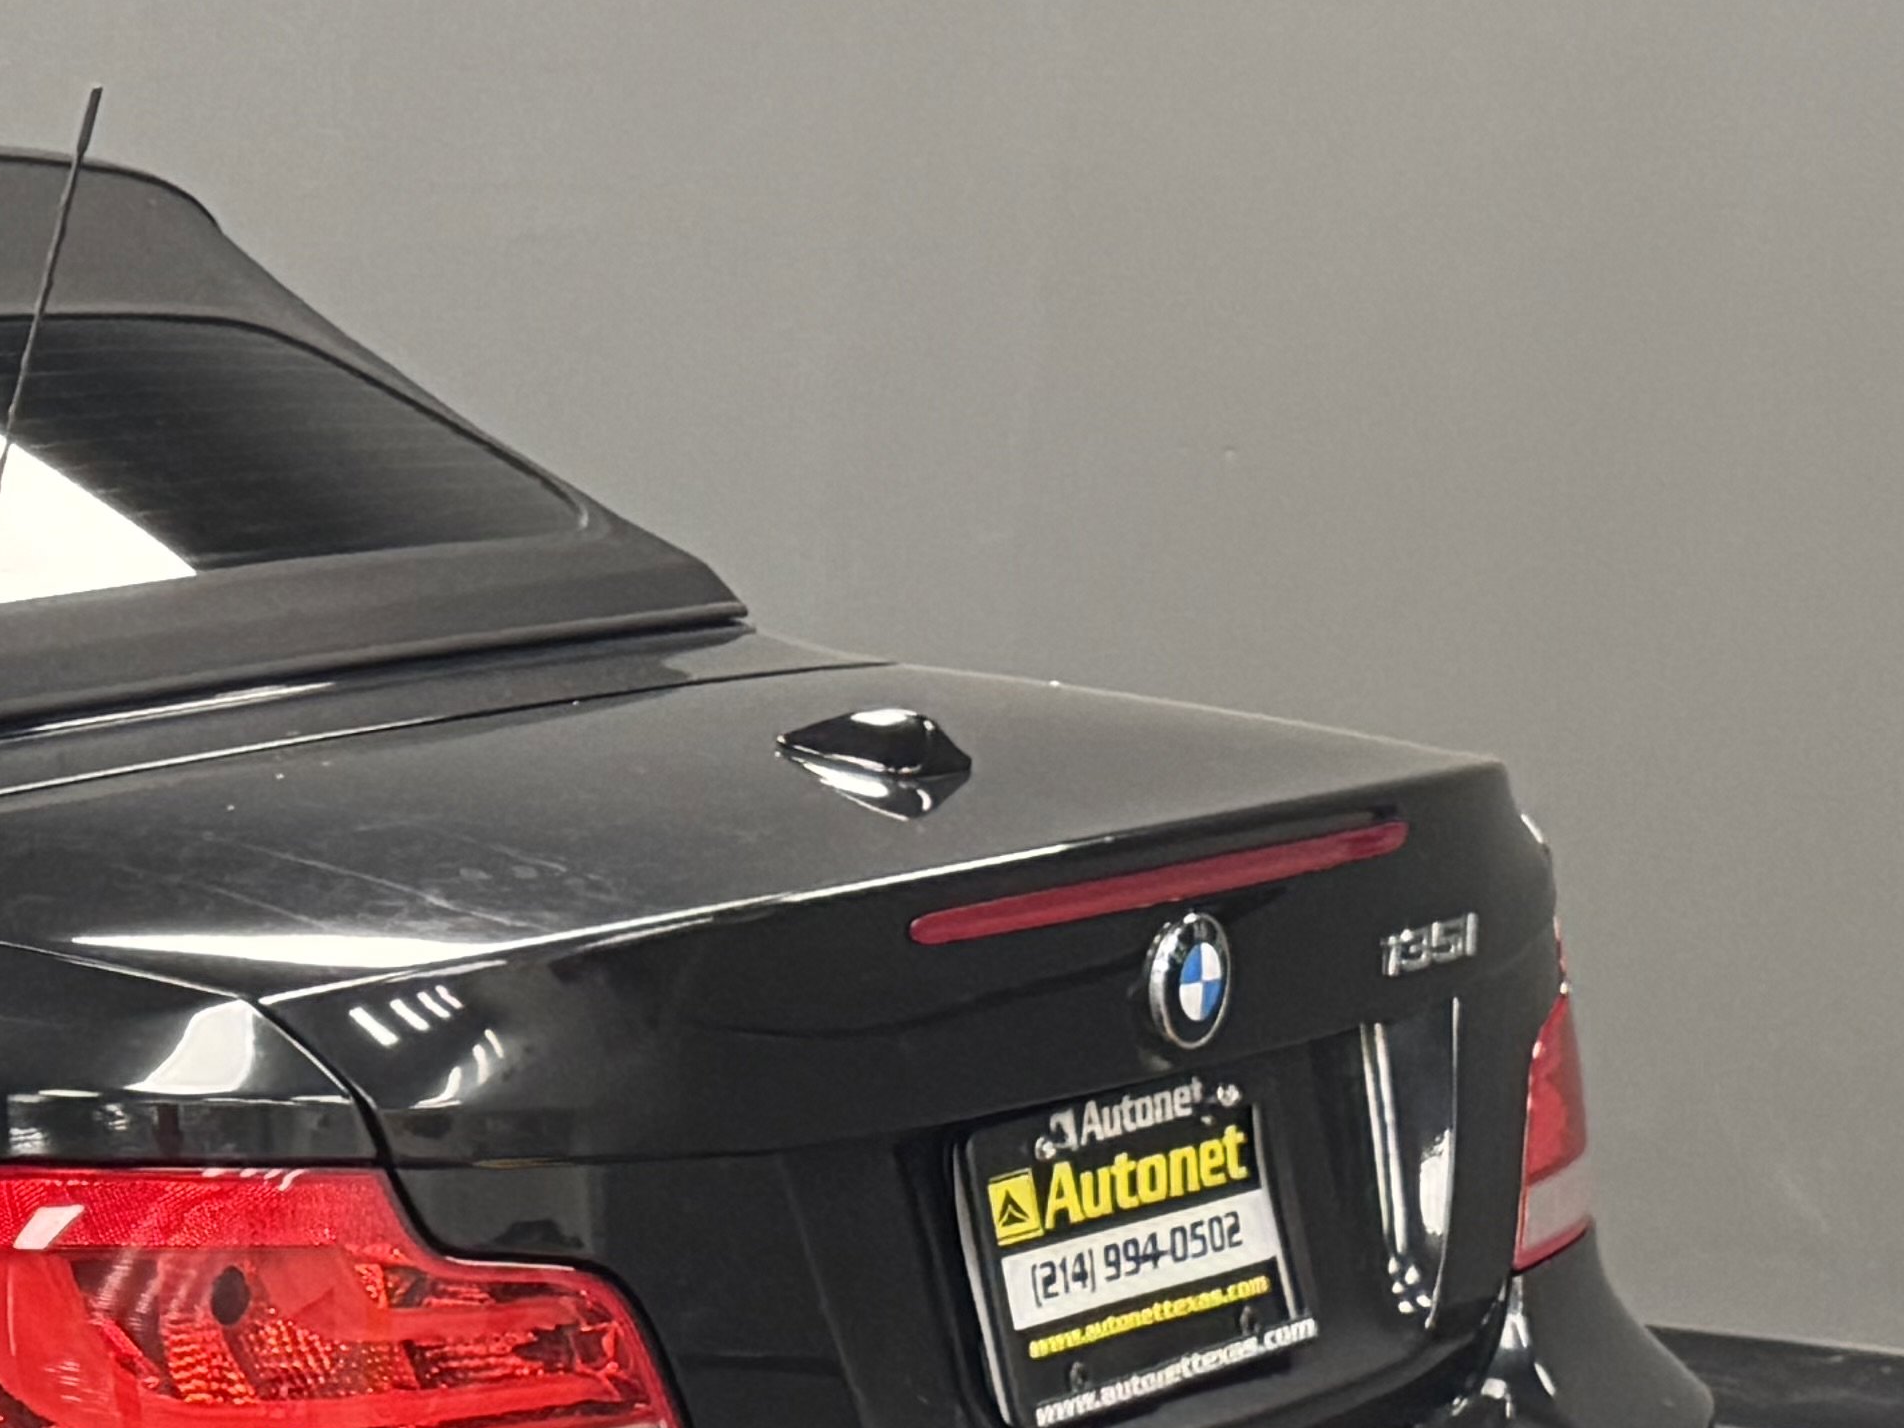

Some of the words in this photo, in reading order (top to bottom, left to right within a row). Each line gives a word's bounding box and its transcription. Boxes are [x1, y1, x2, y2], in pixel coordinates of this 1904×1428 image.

[1080, 1076, 1203, 1144] Autonet
[1044, 1123, 1249, 1230] Autonet
[1031, 1249, 1097, 1307] (214)
[1104, 1211, 1242, 1282] 994-0502
[1028, 1274, 1271, 1359] www.autonettexas.com
[1035, 1317, 1318, 1428] www.autonettexas.com
